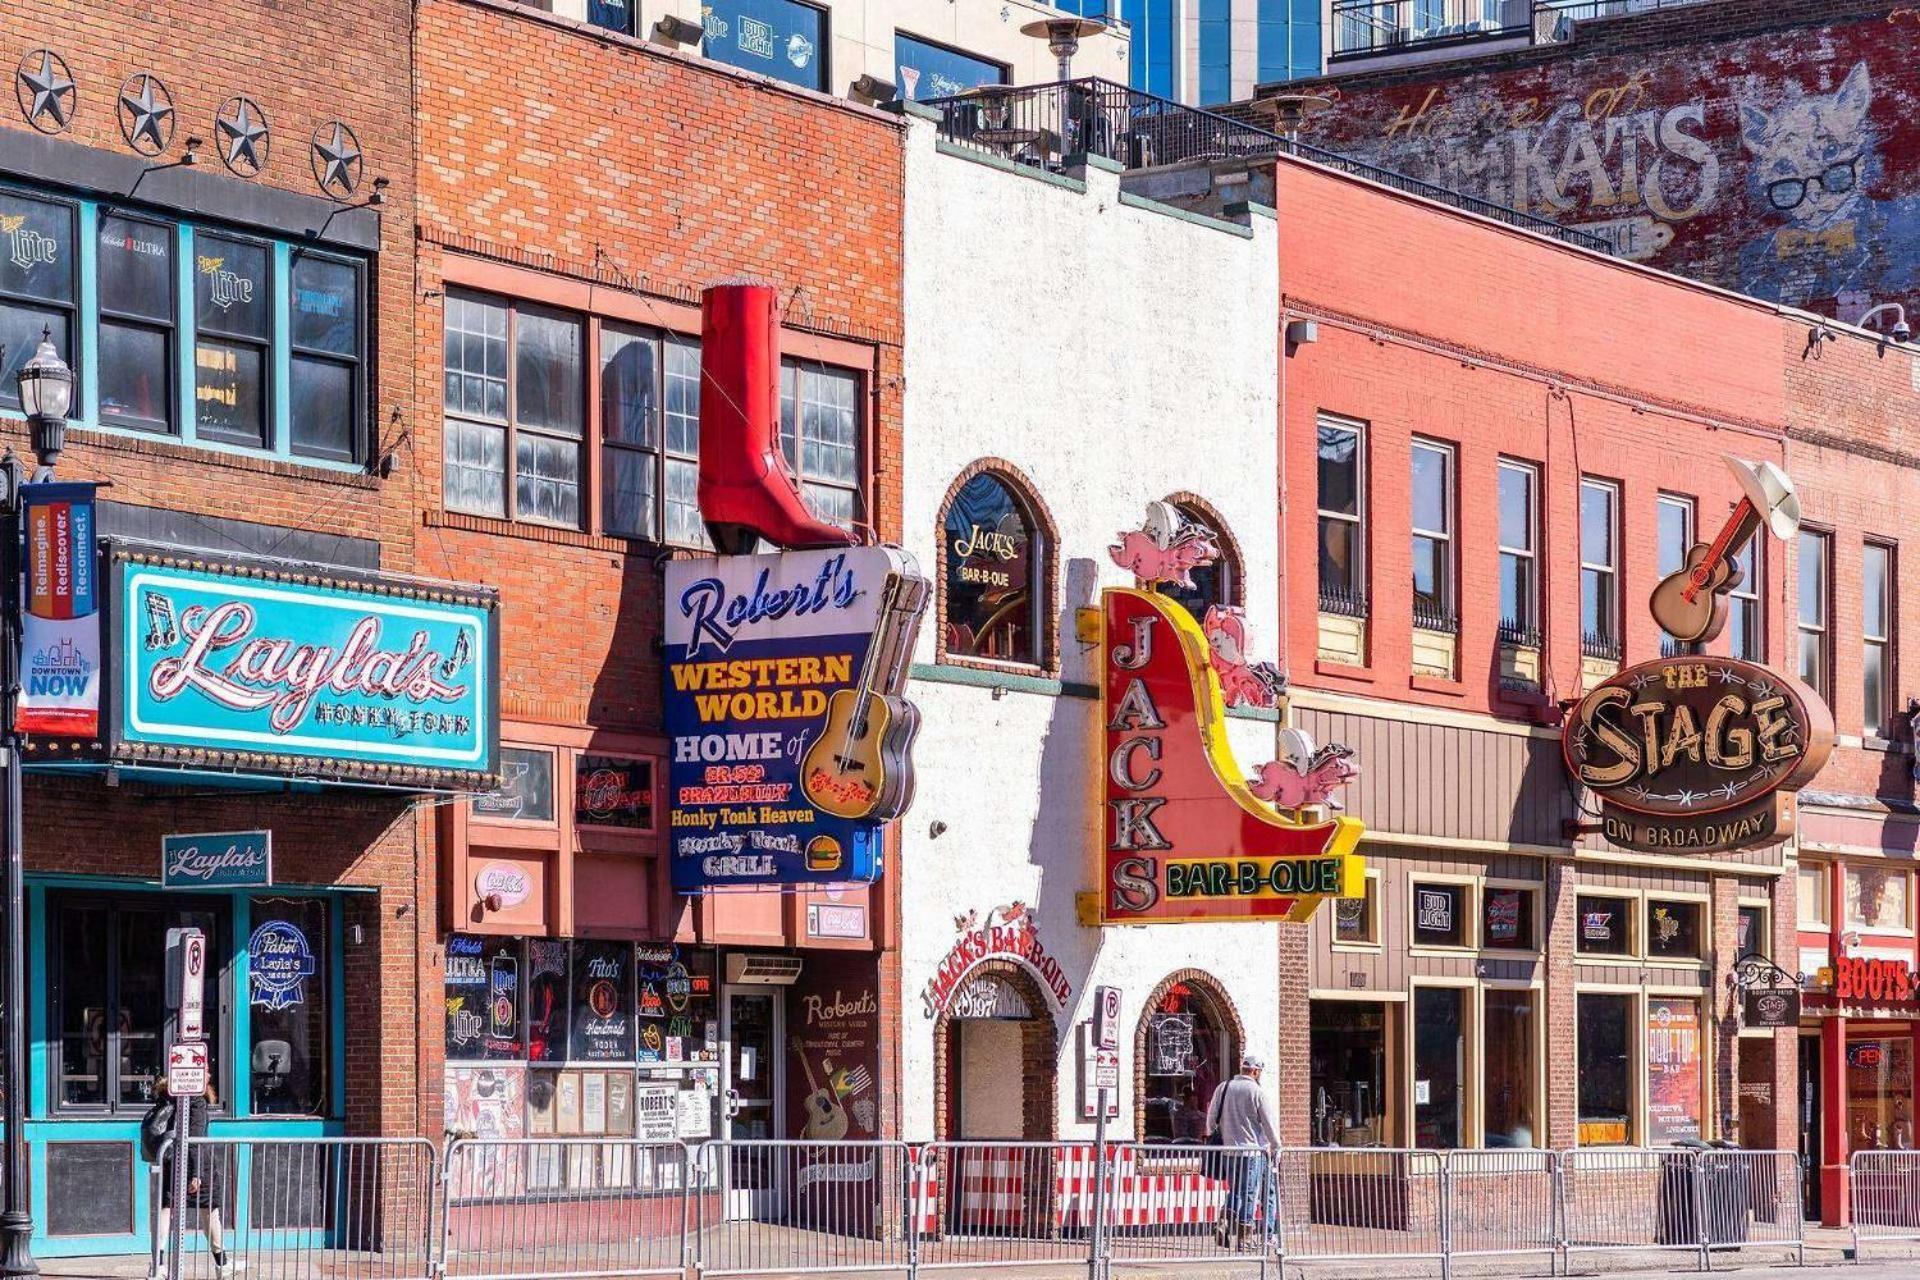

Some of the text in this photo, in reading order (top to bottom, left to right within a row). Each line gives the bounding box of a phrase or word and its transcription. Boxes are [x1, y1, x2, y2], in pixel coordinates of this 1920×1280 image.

[740, 35, 772, 58] LIGHT
[744, 20, 767, 40] BUD
[10, 228, 57, 273] Lite
[132, 240, 165, 257] ULTRA
[210, 268, 253, 313] Lite
[35, 514, 47, 597] Reimagine.
[56, 509, 68, 597] Rediscover.
[76, 512, 88, 597] Reconnect.
[954, 524, 1018, 560] JACK'S
[961, 566, 1010, 588] BAR-B-QUE
[679, 553, 868, 660] Robert's
[30, 675, 90, 697] NOW
[31, 666, 82, 676] DOWNTOWN
[150, 600, 466, 737] Layla's
[671, 655, 853, 692] WESTERN
[1662, 664, 1710, 689] THE
[695, 692, 829, 722] WORLD
[675, 727, 809, 765] HOME of
[1578, 685, 1800, 787] STAGE
[1107, 616, 1173, 913] JACKS
[671, 804, 815, 830] Honky Tonk Heaven
[1606, 811, 1768, 848] ON BROADWAY
[168, 844, 264, 880] Layla's
[702, 854, 778, 878] GRILL
[1166, 860, 1342, 898] BAR-B-QUE
[1421, 909, 1450, 928] LIGHT
[1423, 894, 1446, 910] BUD
[261, 931, 299, 954] Pabst
[260, 956, 301, 974] Layla's
[588, 956, 620, 979] Tito's
[1836, 956, 1909, 1001] BOOTS
[802, 988, 878, 1026] Robert's
[453, 1009, 482, 1047] Lite
[583, 1018, 626, 1037] Handmade
[640, 1095, 675, 1111] ROBERT'S
